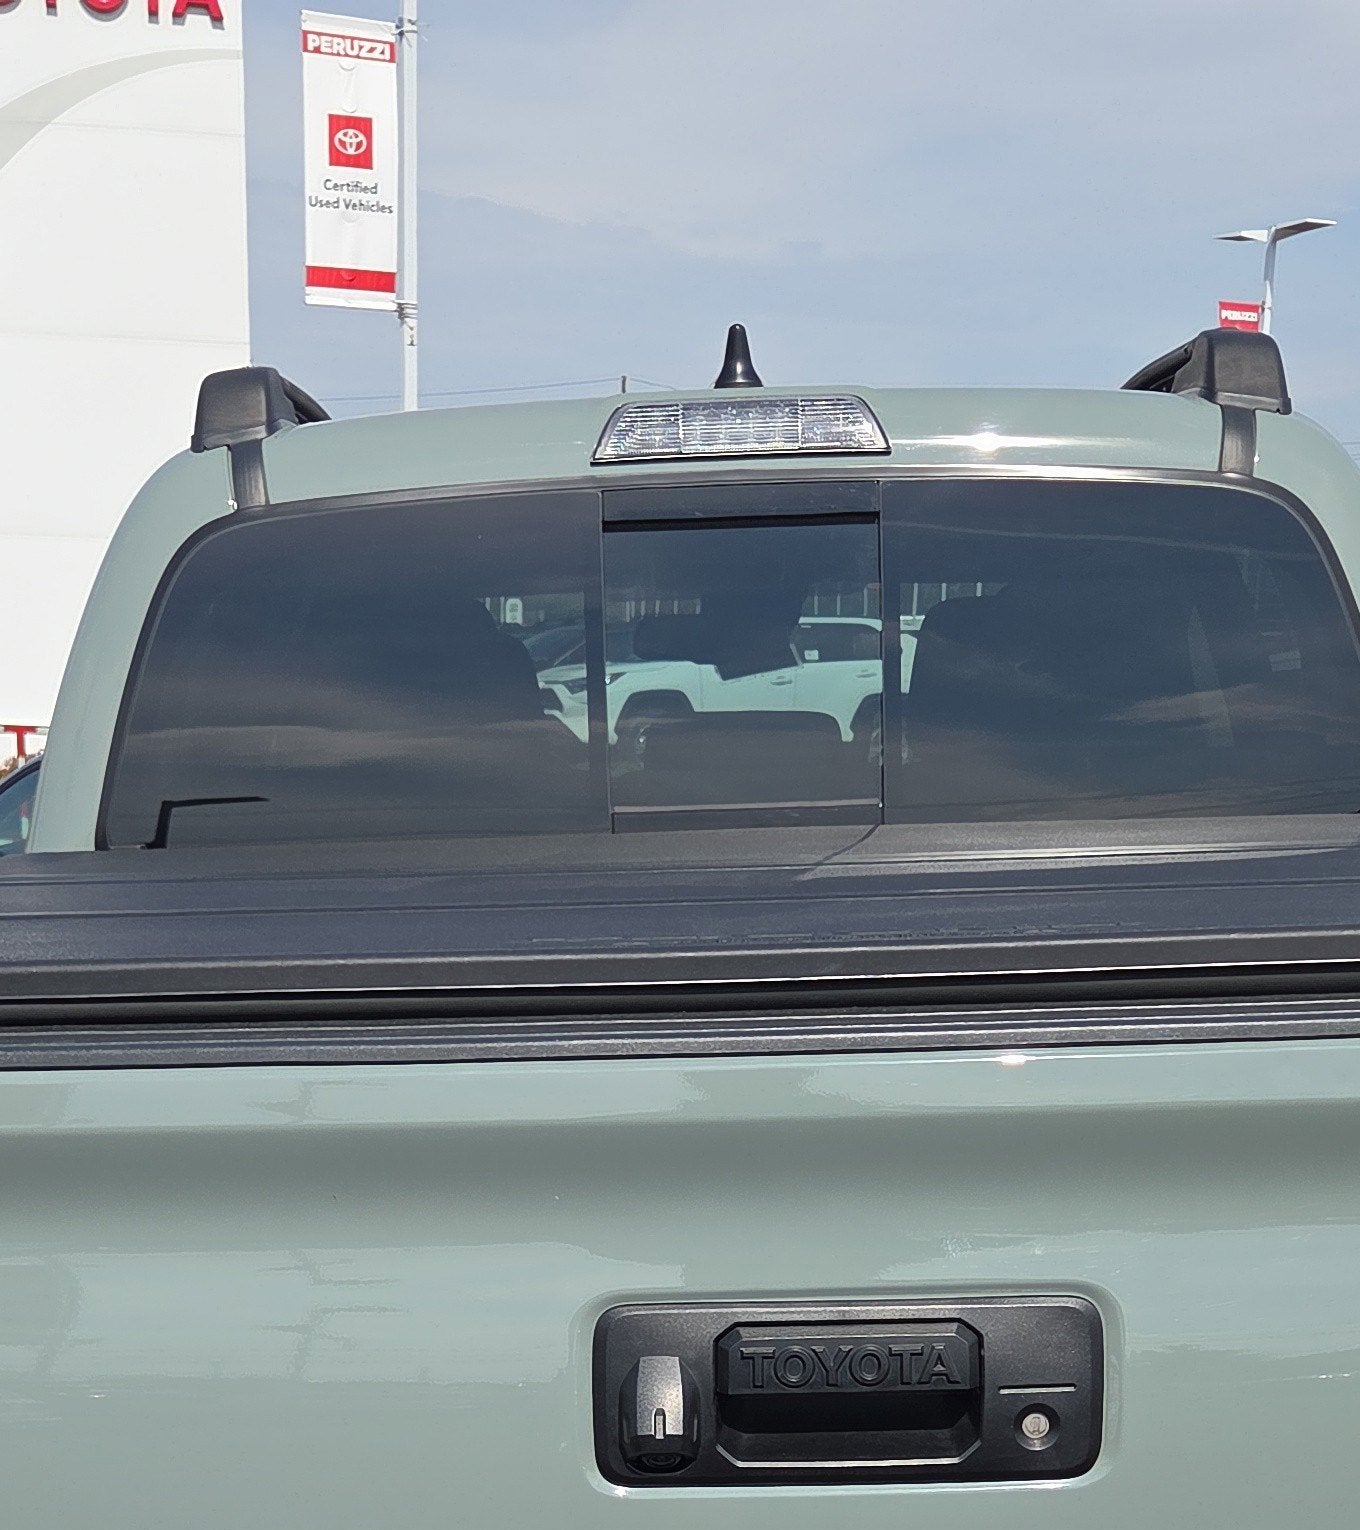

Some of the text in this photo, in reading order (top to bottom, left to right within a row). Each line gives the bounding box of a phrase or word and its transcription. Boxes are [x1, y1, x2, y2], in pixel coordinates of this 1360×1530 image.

[307, 34, 390, 60] PERUZZI
[323, 179, 378, 195] Certified
[308, 196, 393, 214] Used Vehicles
[740, 1343, 961, 1388] TOYOTA
